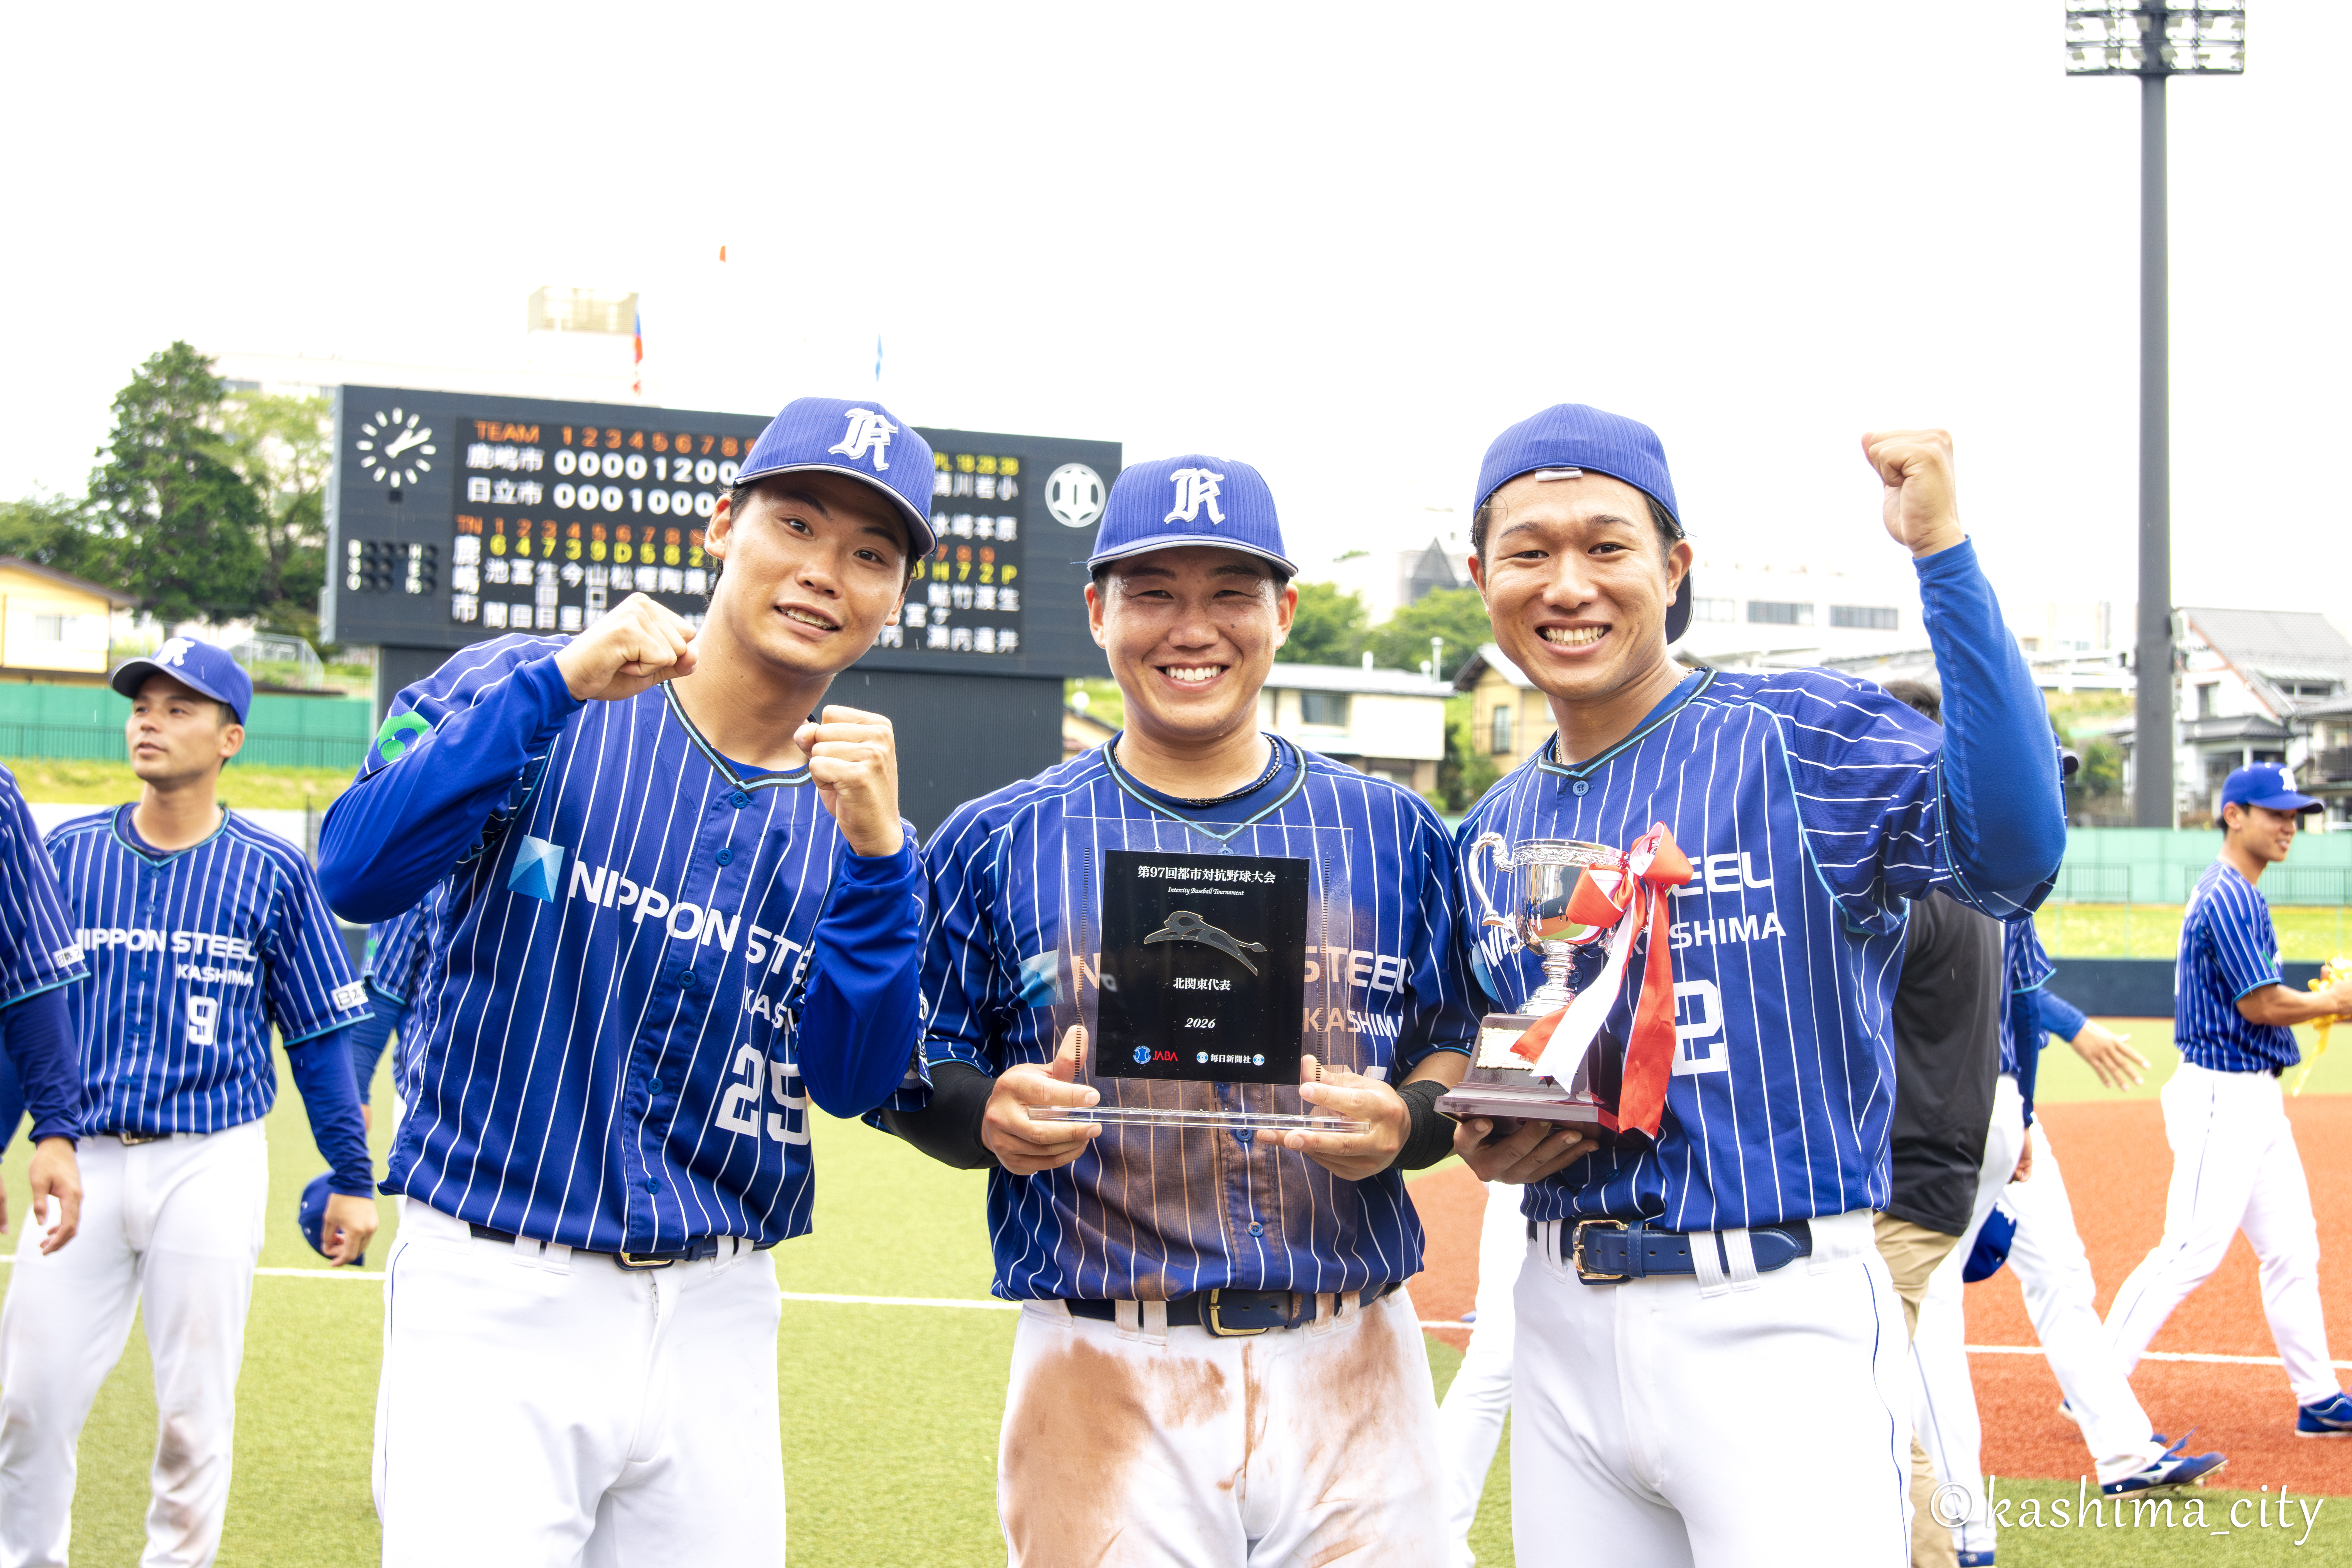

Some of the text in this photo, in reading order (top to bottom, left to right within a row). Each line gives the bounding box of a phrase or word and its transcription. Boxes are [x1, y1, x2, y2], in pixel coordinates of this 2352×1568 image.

[474, 421, 539, 444] TEAM
[562, 426, 573, 446] 1
[582, 427, 598, 447] 2
[605, 428, 622, 449] 3
[629, 431, 644, 450] 4
[652, 432, 668, 452] 5
[675, 434, 692, 453] 6
[700, 435, 715, 455] 7
[721, 436, 738, 456] 8
[467, 476, 544, 506] 日立市
[494, 517, 504, 535] 1
[516, 518, 532, 538] 2
[541, 519, 558, 539] 3
[566, 522, 581, 539] 4
[591, 523, 607, 541] 5
[615, 524, 631, 543] 6
[640, 526, 656, 543] 7
[664, 527, 681, 546] 8
[490, 534, 507, 556] 6
[515, 536, 531, 557] 4
[541, 537, 557, 558] 7
[565, 539, 582, 560] 3
[590, 540, 607, 562] 9
[614, 542, 632, 563] D
[640, 543, 656, 564] 5
[664, 544, 681, 566] 8
[956, 562, 972, 582] 7
[979, 563, 994, 583] 2
[1002, 564, 1017, 585] P
[1138, 865, 1276, 884] 第97回都市対抗野球大会
[1671, 852, 1772, 897] EEL
[1168, 887, 1190, 895] Intercity
[570, 861, 810, 984] NIPPON STE
[1669, 912, 1787, 950] SHIMA
[171, 930, 257, 962] STEEL
[177, 964, 254, 987] KASHIMA
[1173, 977, 1231, 991] 北関東代表
[188, 995, 218, 1046] 9
[1184, 1018, 1216, 1029] 2026
[1152, 1050, 1178, 1061] JABA
[1210, 1054, 1251, 1064] 毎日新聞社
[715, 1043, 811, 1145] 25
